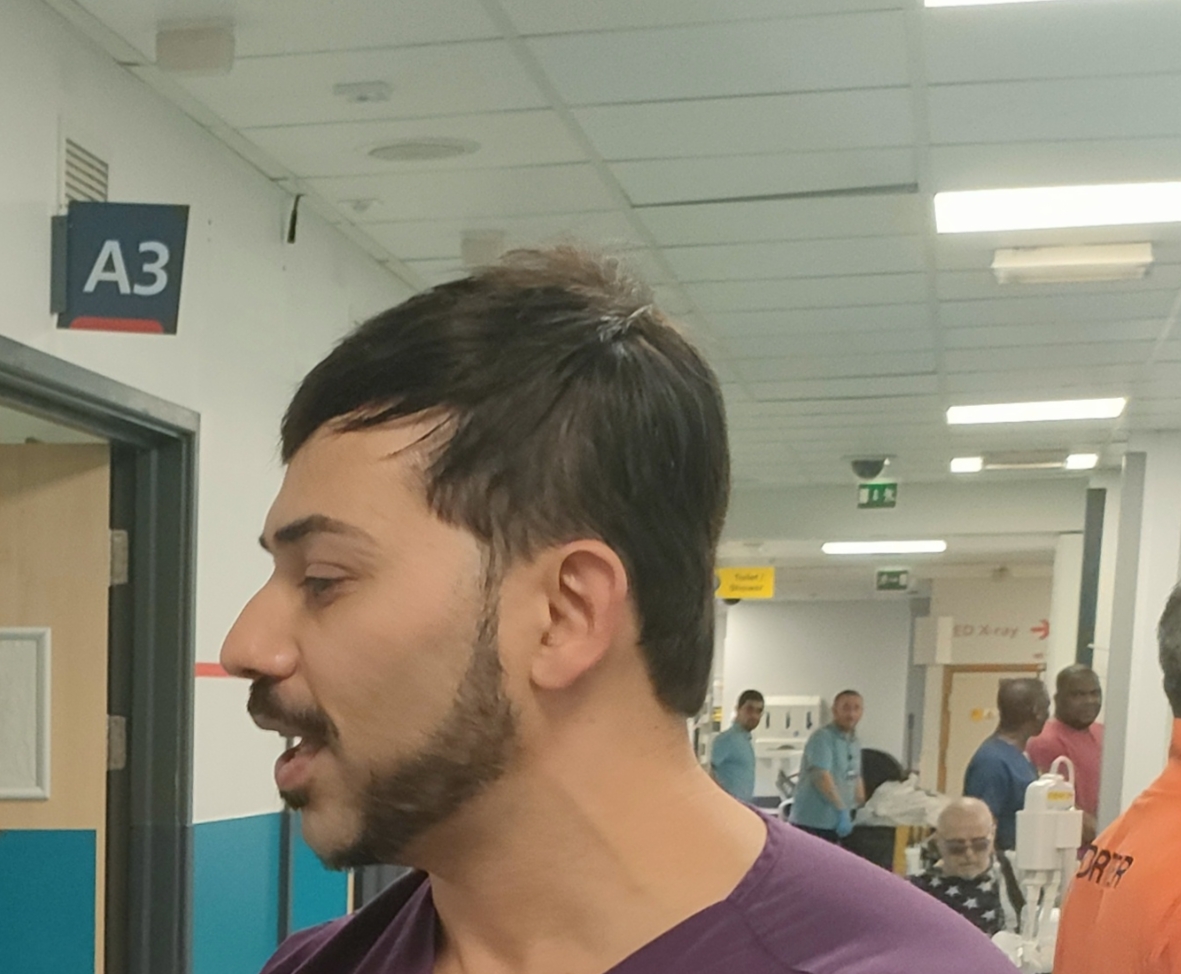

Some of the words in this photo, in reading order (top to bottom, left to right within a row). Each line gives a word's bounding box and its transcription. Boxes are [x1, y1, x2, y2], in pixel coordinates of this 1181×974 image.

[82, 239, 170, 297] A3
[953, 624, 974, 637] ED
[978, 624, 1018, 639] X-ray
